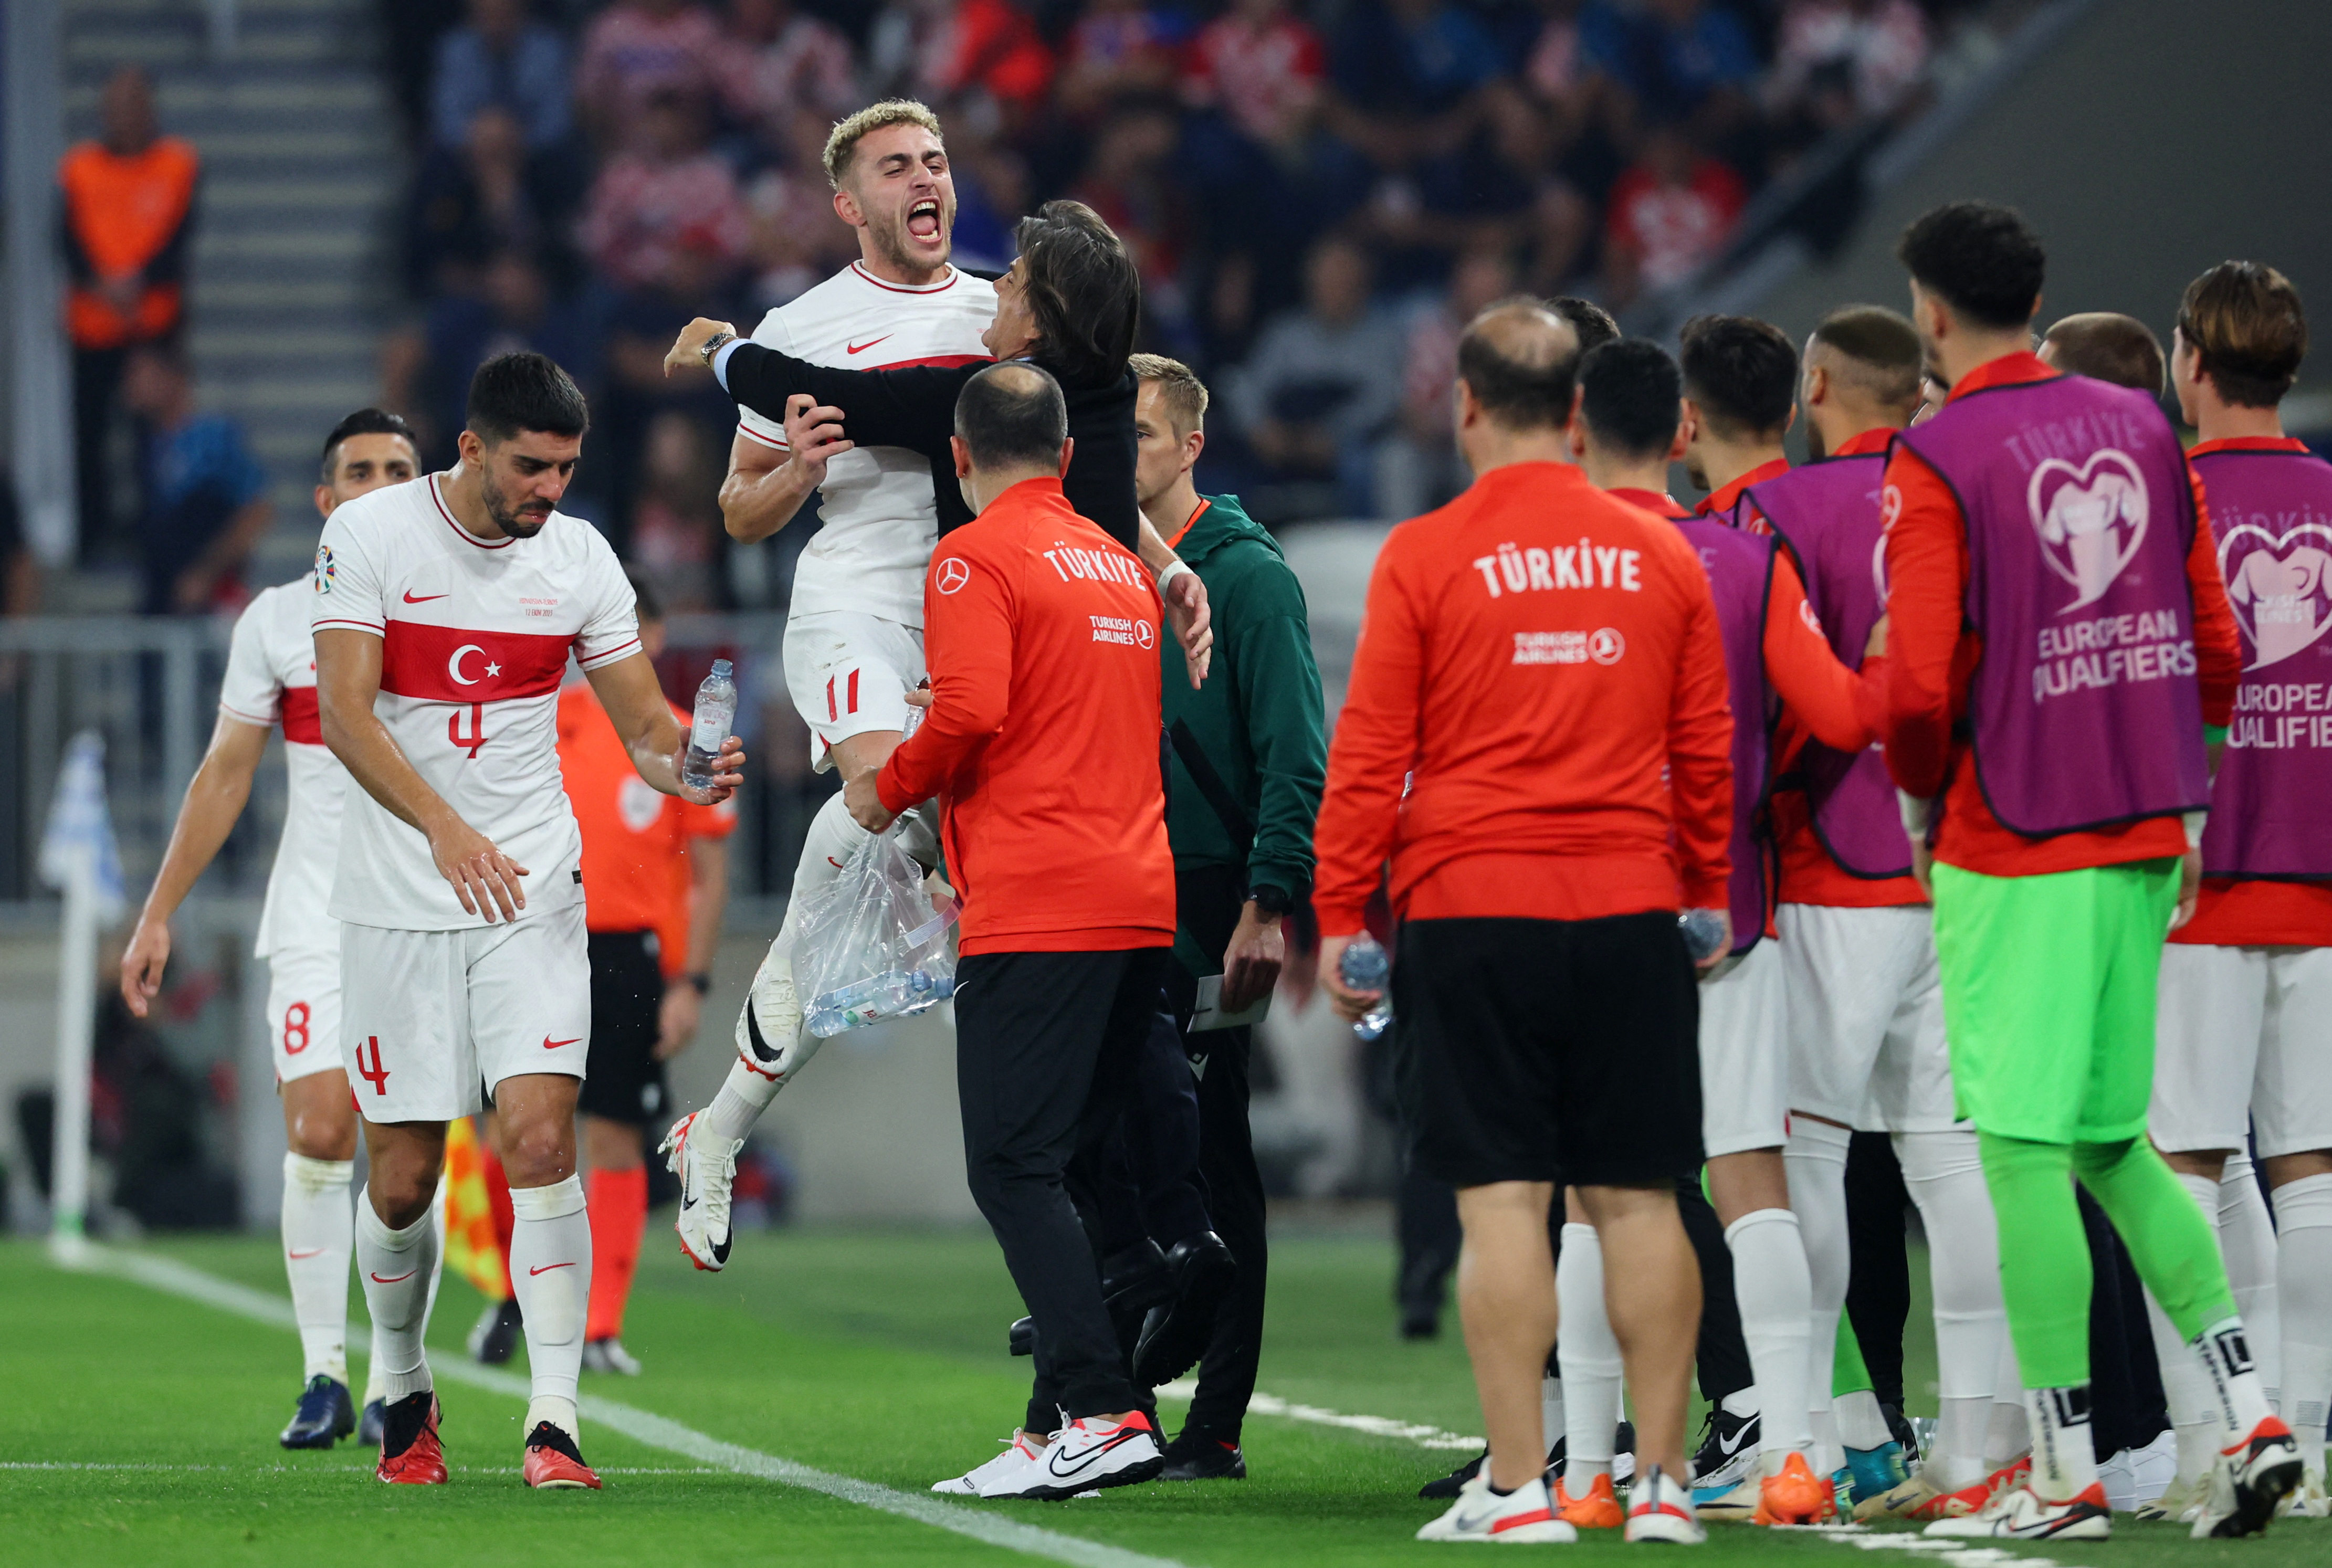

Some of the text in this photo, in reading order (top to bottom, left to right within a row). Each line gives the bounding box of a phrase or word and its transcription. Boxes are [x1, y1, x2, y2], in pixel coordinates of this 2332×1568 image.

[1043, 540, 1147, 592] TÜRKİYE
[1474, 538, 1642, 598] TÜRKİYE
[1089, 615, 1132, 631] TURKISH
[1093, 629, 1135, 645] AIRLINES
[826, 667, 860, 723] 11
[448, 702, 489, 759] 4
[285, 1001, 310, 1056] 8
[355, 1036, 391, 1096] 4
